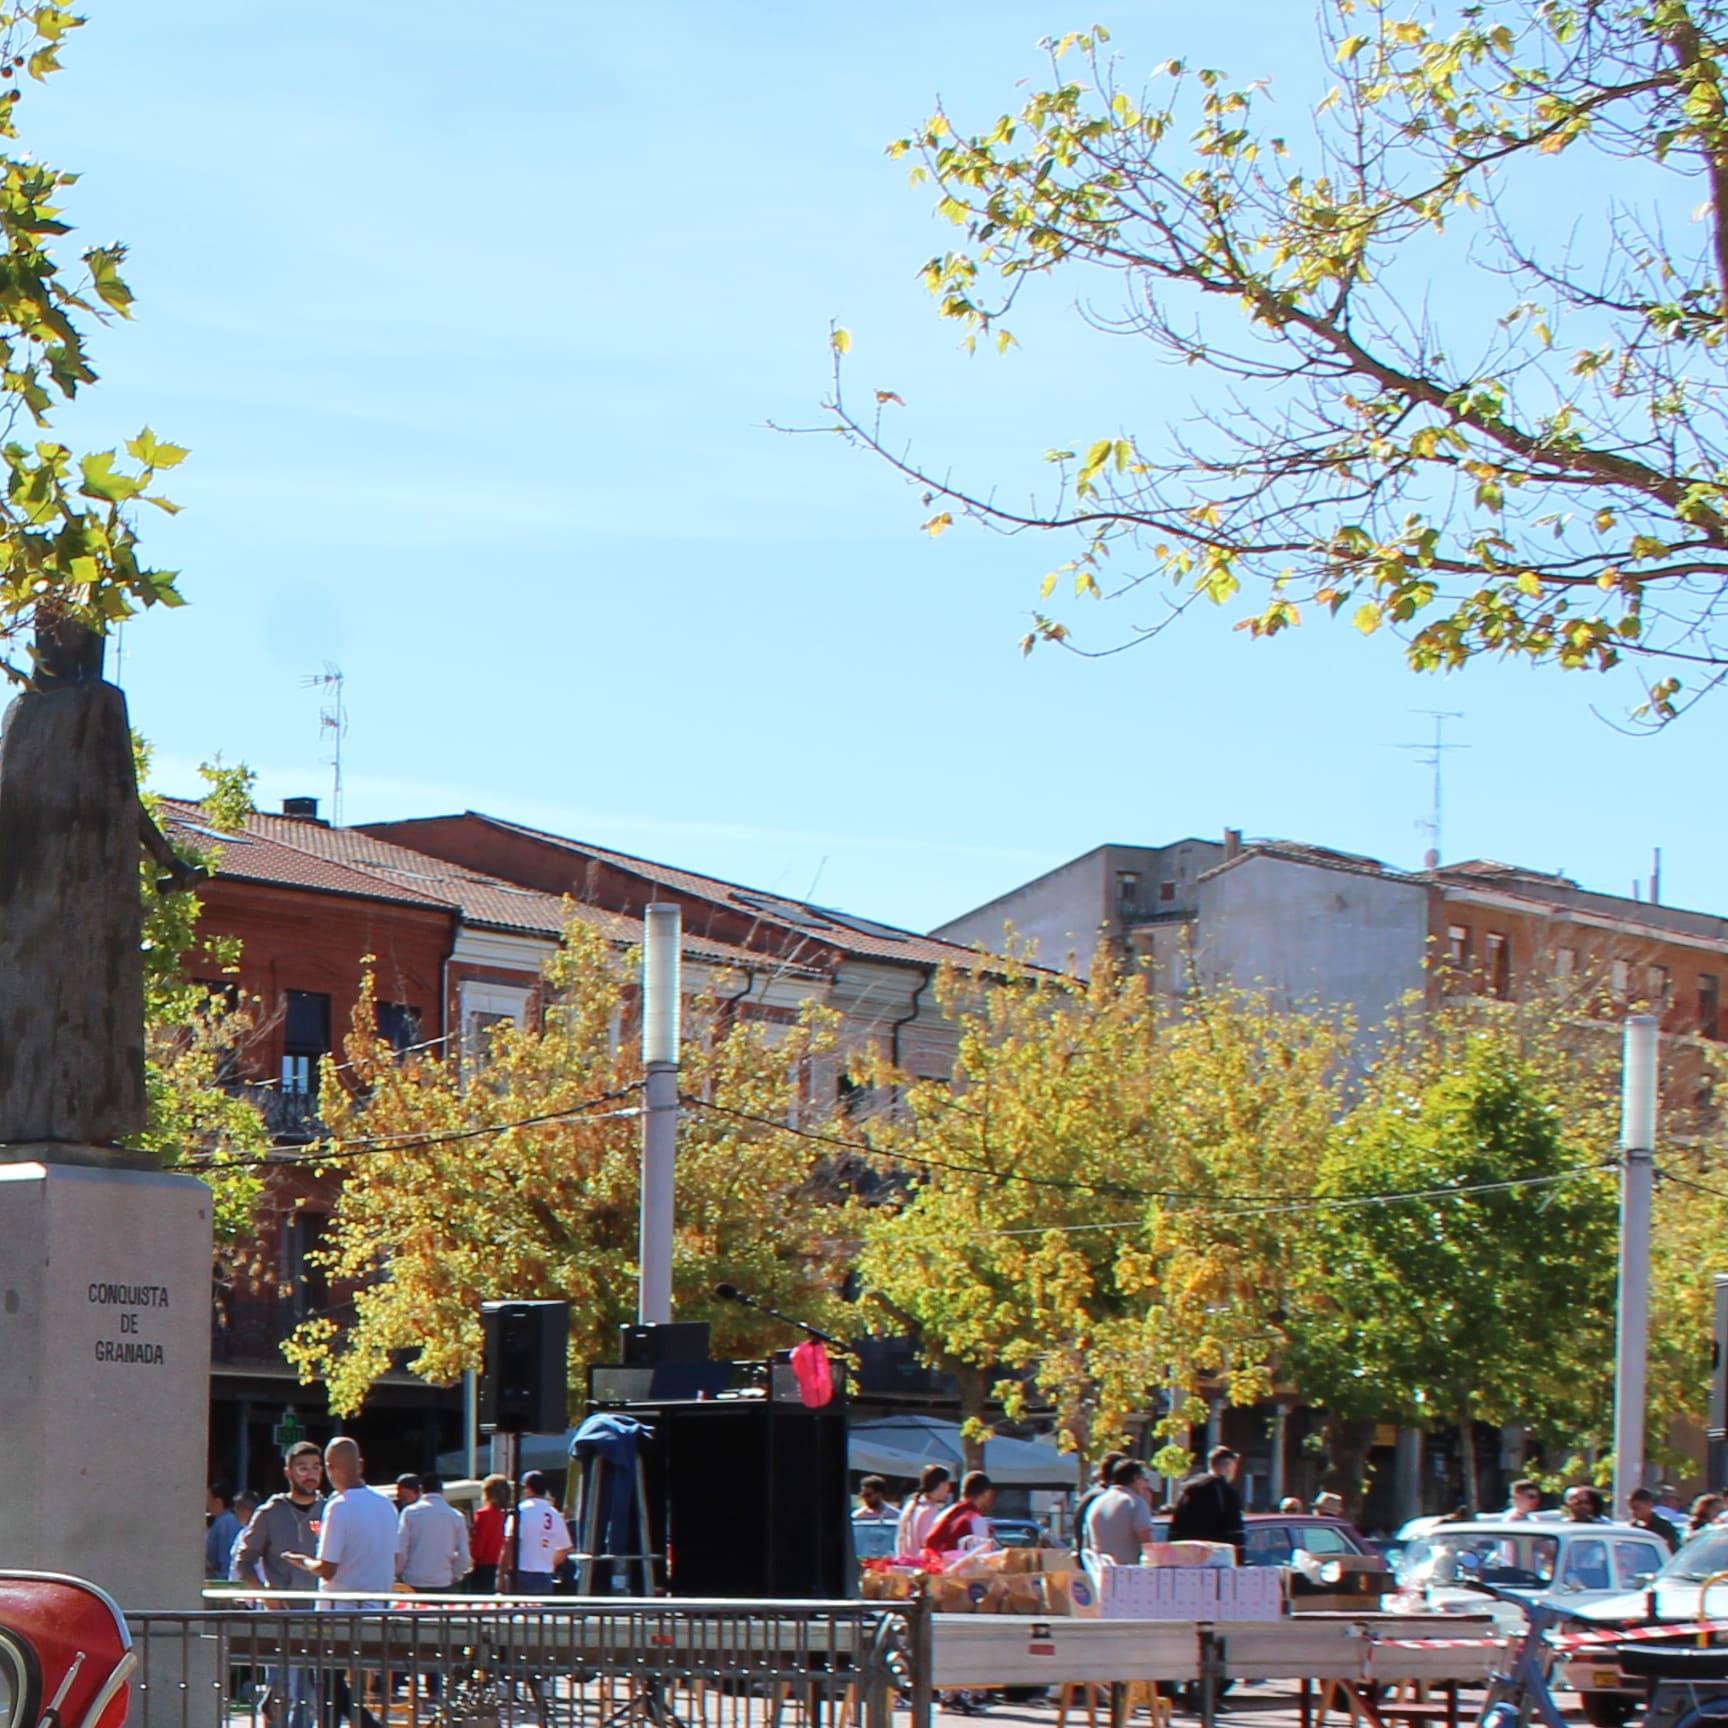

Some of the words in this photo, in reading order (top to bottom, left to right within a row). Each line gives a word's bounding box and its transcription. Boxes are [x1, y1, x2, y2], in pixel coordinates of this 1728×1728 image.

[88, 1283, 169, 1307] CONQUISTA
[120, 1313, 139, 1334] DE
[95, 1340, 164, 1364] GRANADA
